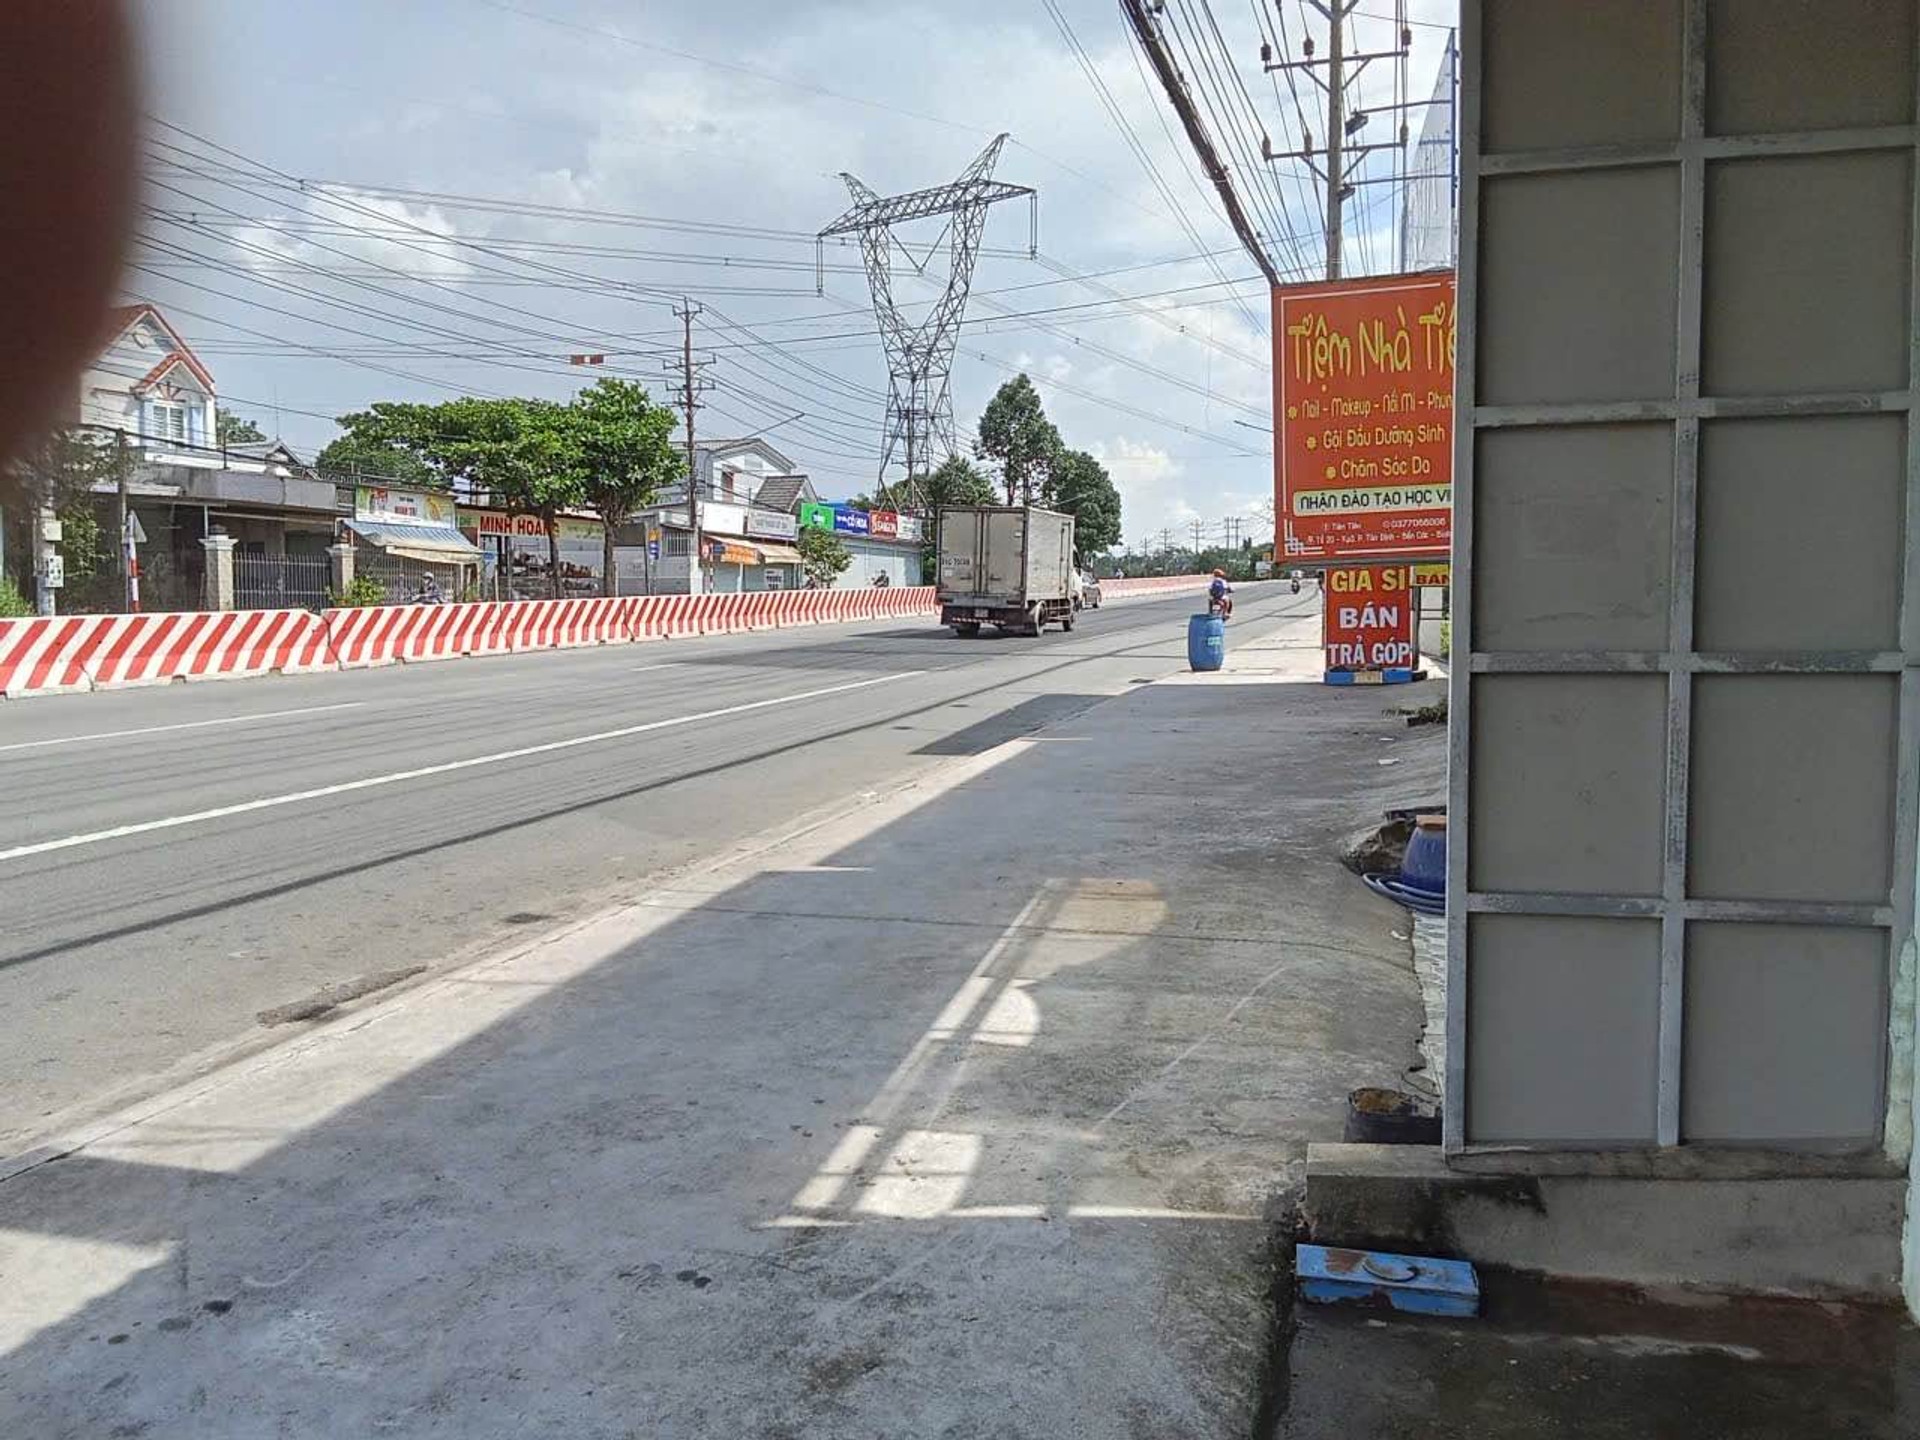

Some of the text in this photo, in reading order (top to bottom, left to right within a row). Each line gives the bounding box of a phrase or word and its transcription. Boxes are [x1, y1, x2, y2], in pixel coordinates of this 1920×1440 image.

[1288, 313, 1350, 392] Tiệm
[1359, 305, 1411, 377] Nhà
[1331, 398, 1371, 418] Makeup
[1323, 431, 1342, 452] Gội
[1417, 424, 1446, 443] Sinh
[1382, 454, 1407, 475] Sóc
[1300, 492, 1337, 511] NHẬN
[1342, 490, 1370, 508] ĐÀO
[1374, 492, 1401, 509] TẠO
[1405, 490, 1432, 507] HỌC
[480, 516, 513, 534] MINH
[1339, 601, 1398, 628] BÁN
[1328, 635, 1410, 665] TRẢ GÓP
